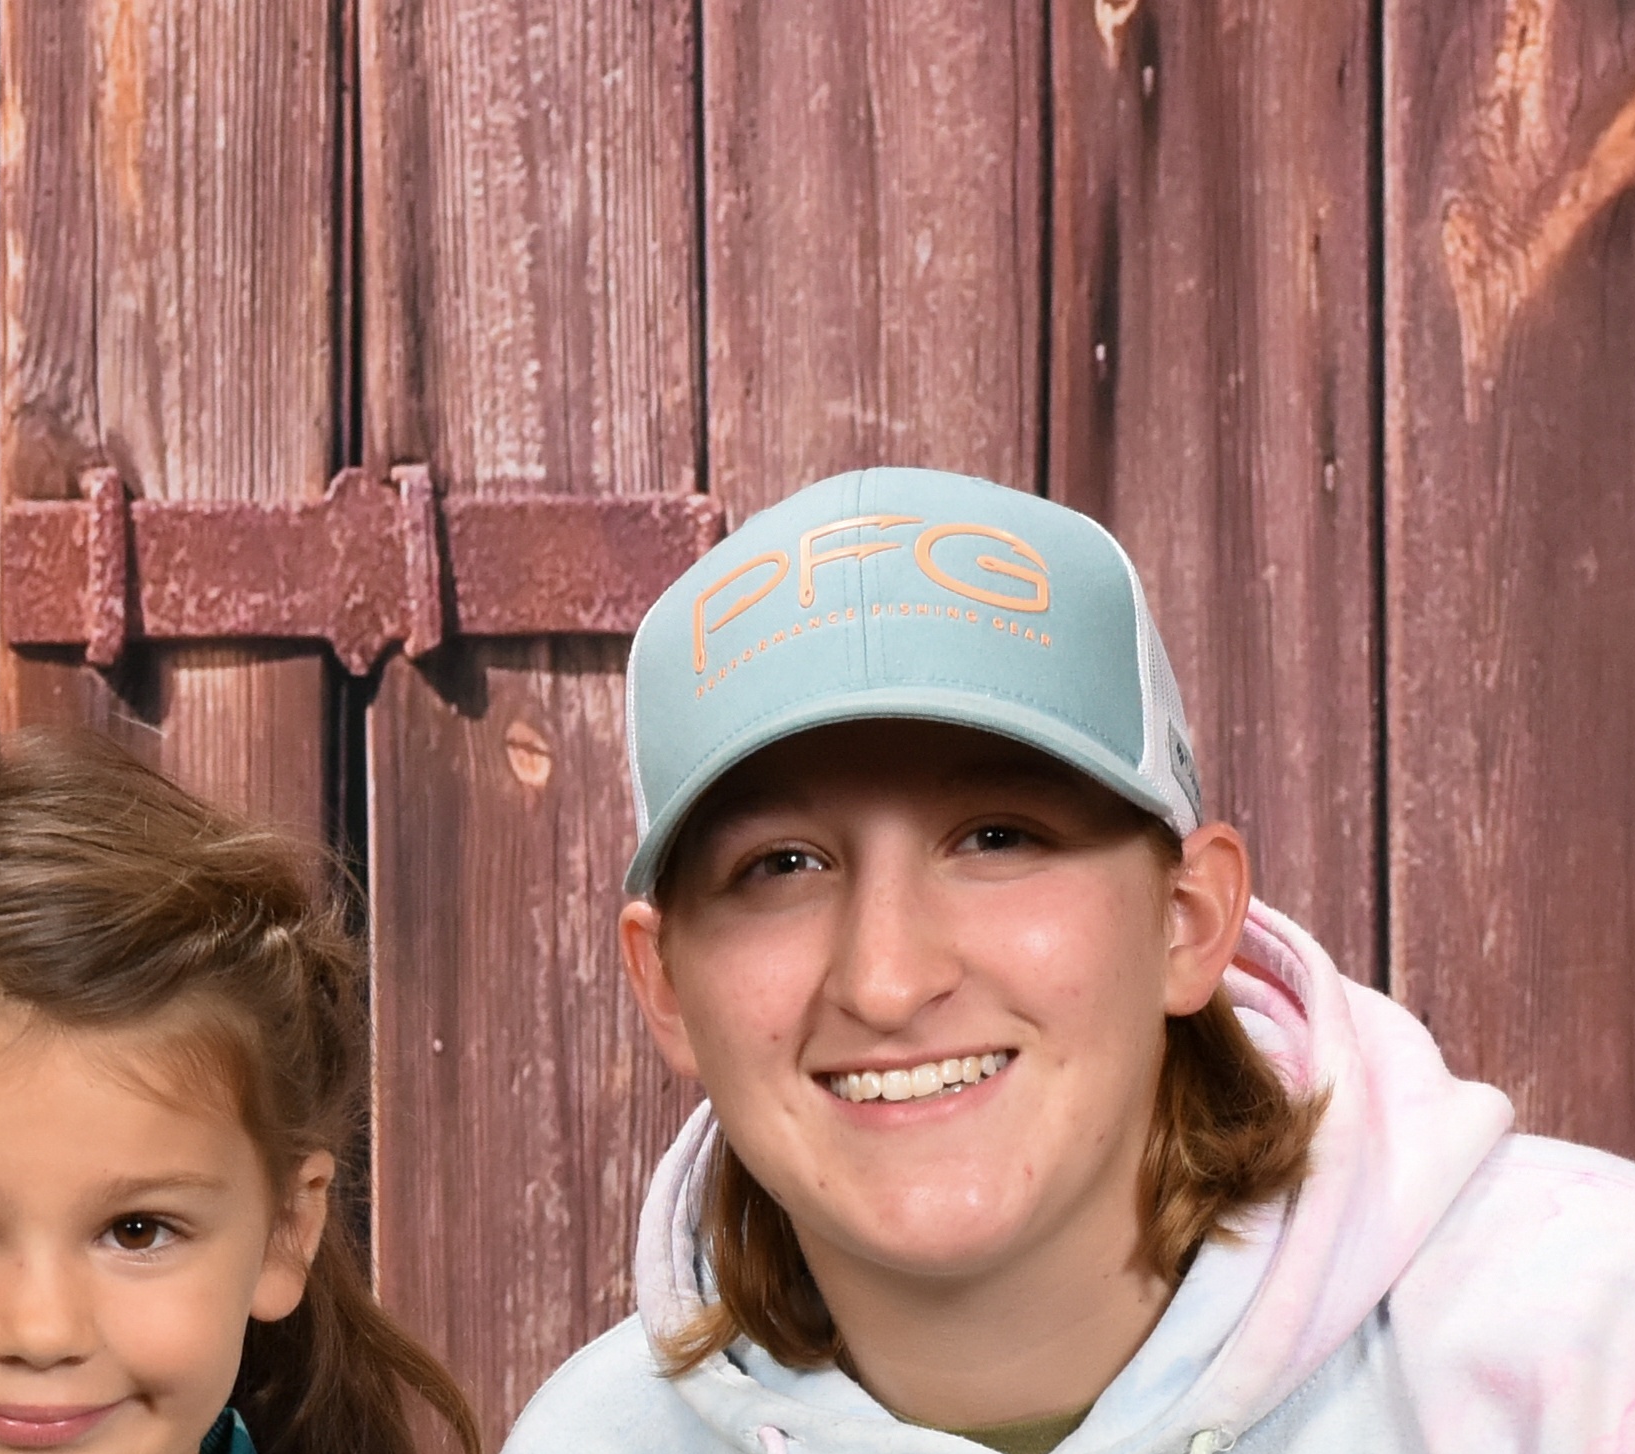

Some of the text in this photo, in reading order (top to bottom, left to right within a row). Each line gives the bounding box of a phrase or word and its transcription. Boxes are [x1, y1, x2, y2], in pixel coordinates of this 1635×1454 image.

[692, 514, 1049, 674] PFG
[695, 602, 1053, 699] PERFORMANCE FISHING GEAR
